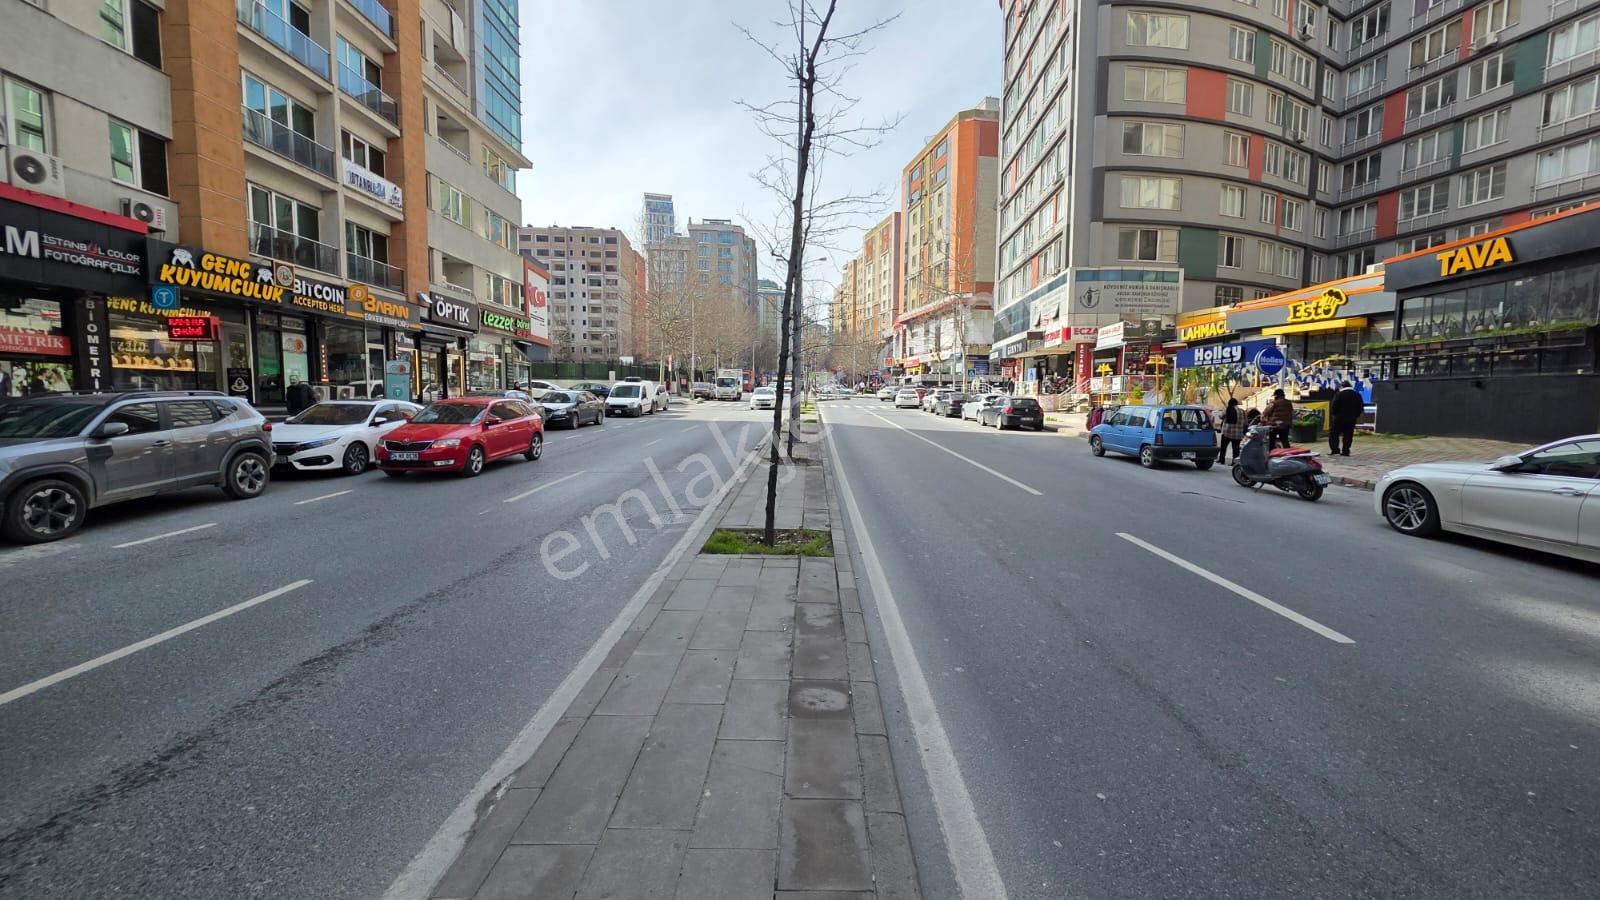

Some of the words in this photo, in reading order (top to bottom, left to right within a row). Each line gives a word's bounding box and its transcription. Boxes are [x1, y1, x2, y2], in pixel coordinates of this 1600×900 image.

[0, 225, 40, 259] M
[44, 249, 140, 276] FOTOĞRAFÇILIK
[107, 249, 140, 262] COLOR
[1436, 237, 1513, 277] TAVA
[160, 264, 284, 304] KUYUMCULUK
[293, 295, 328, 310] ACCEPTED
[328, 303, 345, 314] HERE
[1194, 345, 1242, 362] Holley
[1260, 355, 1284, 365] Holley
